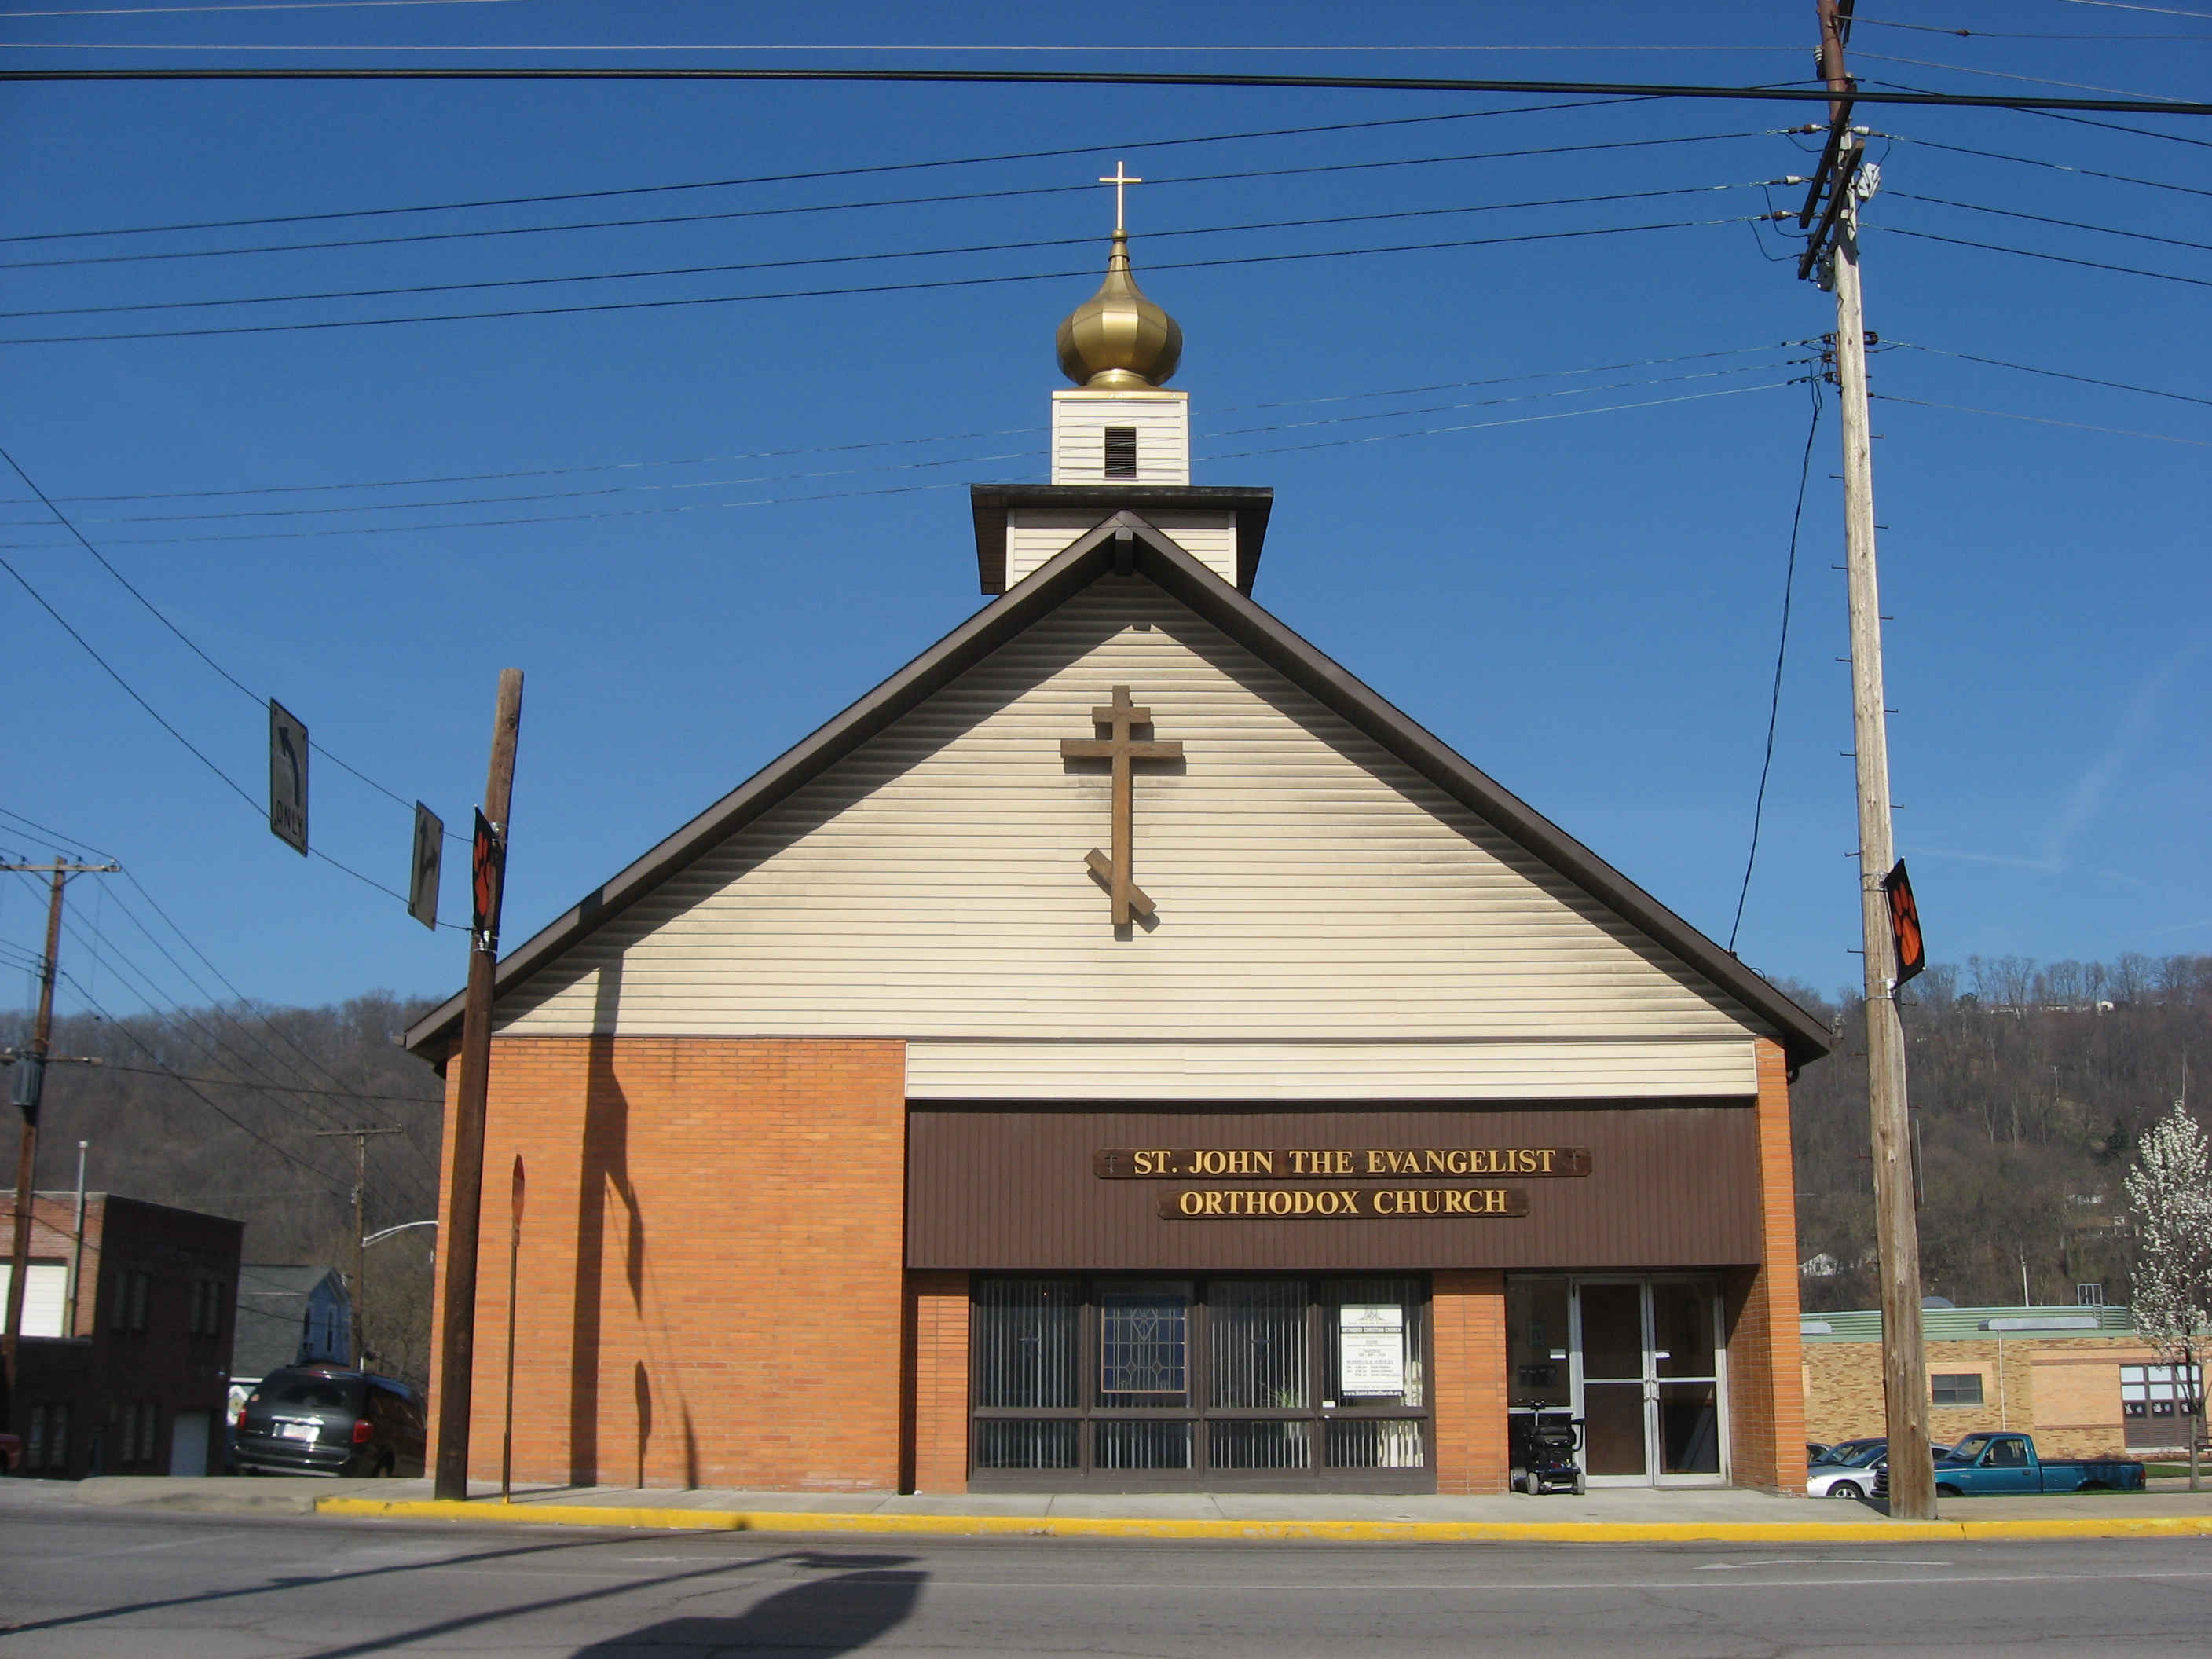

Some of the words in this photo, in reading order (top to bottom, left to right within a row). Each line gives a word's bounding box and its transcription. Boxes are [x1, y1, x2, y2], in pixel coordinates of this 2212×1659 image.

[276, 800, 303, 839] ONLY
[1133, 1150, 1178, 1174] ST.
[1188, 1150, 1274, 1174] JOHN
[1288, 1149, 1354, 1174] THE
[1366, 1149, 1556, 1174] EVANGELIST
[1180, 1190, 1360, 1215] ORTHODOX
[1373, 1189, 1507, 1214] CHURCH
